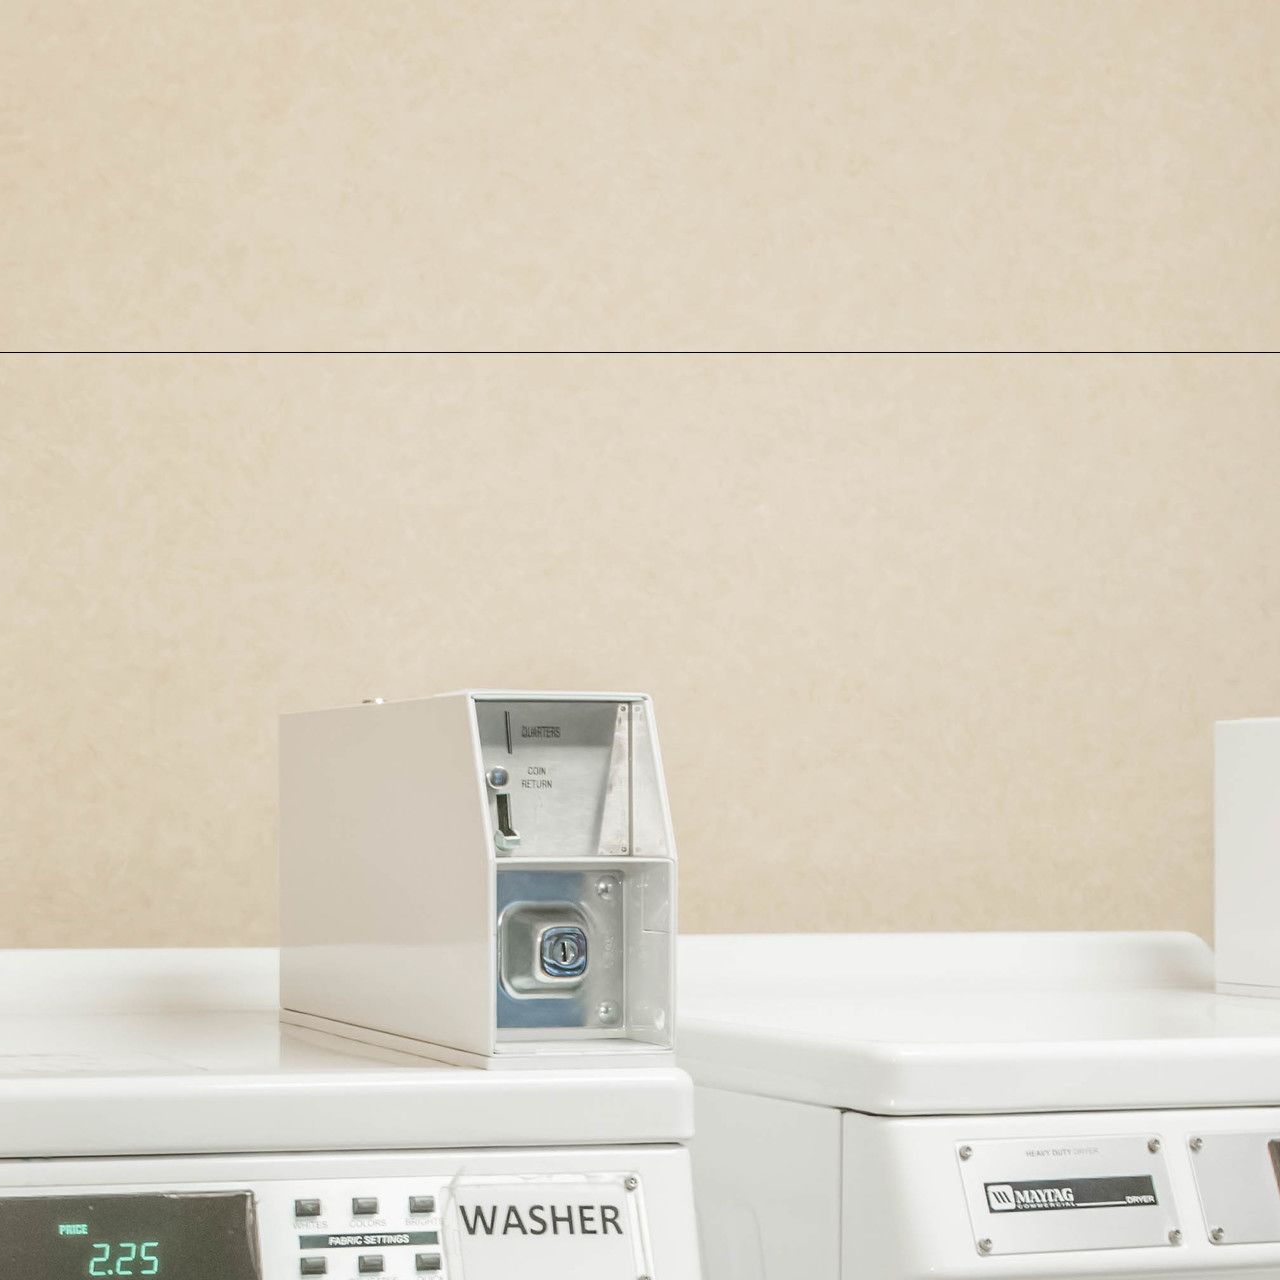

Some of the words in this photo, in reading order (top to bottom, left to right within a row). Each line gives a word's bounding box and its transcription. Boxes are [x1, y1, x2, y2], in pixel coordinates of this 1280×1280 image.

[521, 726, 561, 738] QUARTERS
[527, 767, 547, 775] COIN
[521, 780, 552, 788] RETURN
[1014, 1187, 1075, 1204] MAYTAG
[1125, 1195, 1155, 1204] DRYER
[459, 1205, 623, 1235] WASHER
[59, 1224, 88, 1235] PRICE
[329, 1236, 363, 1246] FABRIC
[364, 1234, 410, 1245] SETTINGS
[89, 1242, 159, 1276] 2.25
